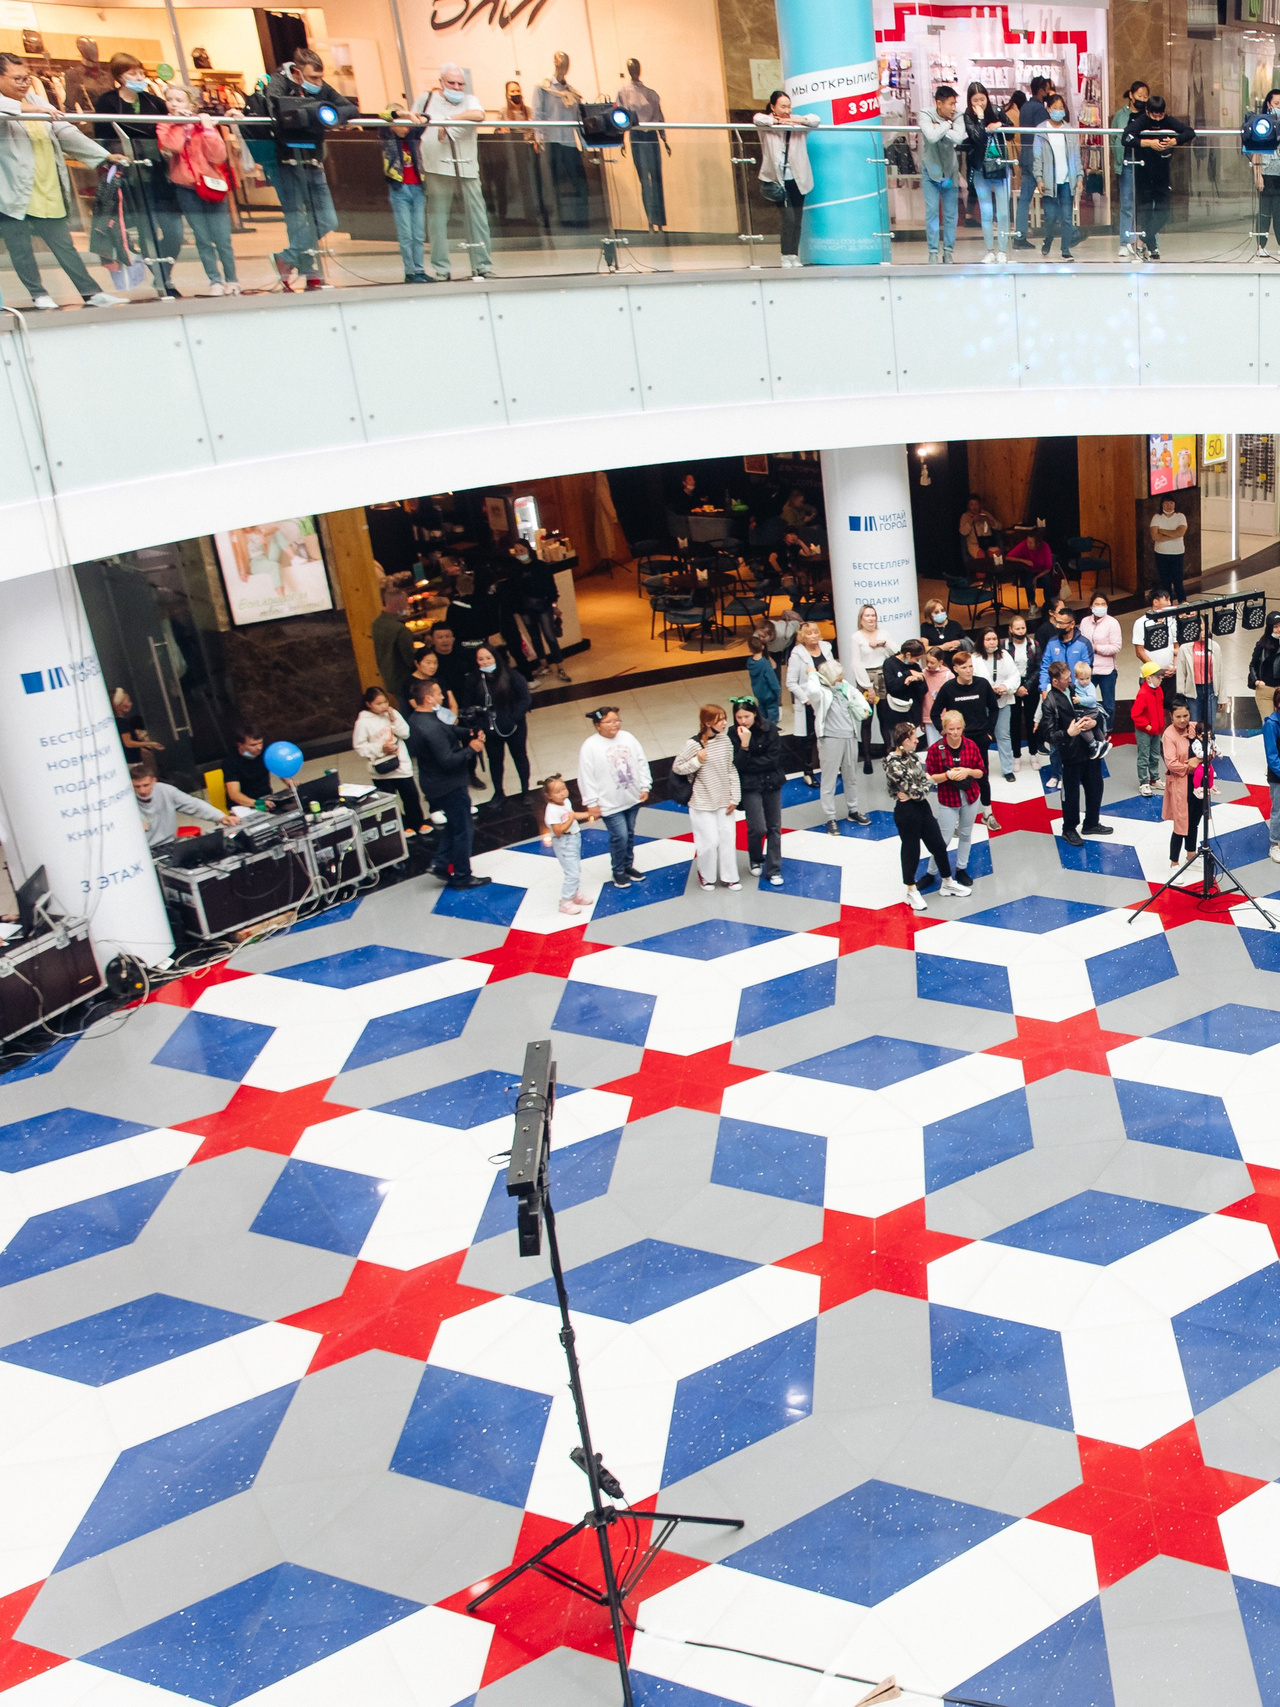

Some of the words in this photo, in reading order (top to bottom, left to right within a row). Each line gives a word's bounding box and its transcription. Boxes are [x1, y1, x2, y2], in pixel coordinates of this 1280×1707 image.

[792, 85, 808, 96] МЫ
[811, 72, 878, 92] ОТКРЫЛИС
[859, 97, 880, 113] ЭТА
[879, 510, 906, 522] ЧИТАЙ
[879, 519, 907, 531] ГОРОД
[852, 559, 910, 570] БЕСТСЕЛЛЕРЫ
[853, 578, 900, 588] НОВИНКИ
[855, 596, 900, 606] ПОДАРКИ
[877, 610, 913, 623] ЦЕЛЯРИЯ
[46, 745, 112, 772] НОВИНКИ
[54, 768, 118, 797] ПОДАРКИ
[66, 821, 116, 843] КНИГИ
[97, 861, 145, 891] ЭТАЖ
